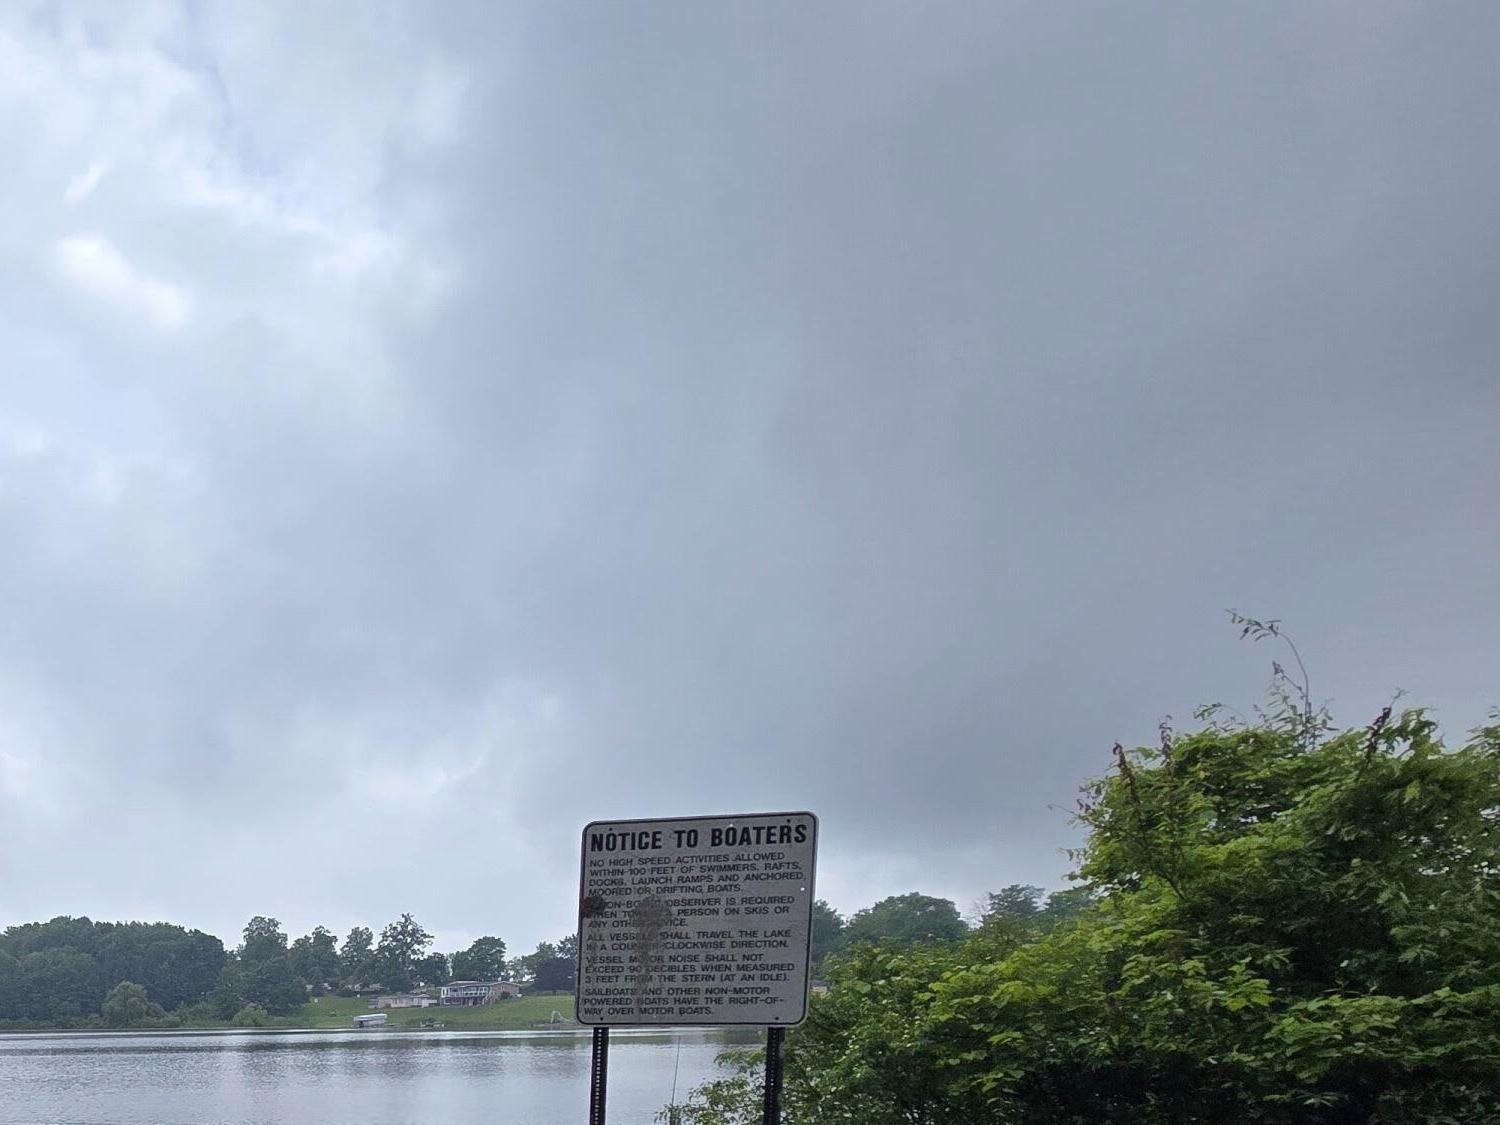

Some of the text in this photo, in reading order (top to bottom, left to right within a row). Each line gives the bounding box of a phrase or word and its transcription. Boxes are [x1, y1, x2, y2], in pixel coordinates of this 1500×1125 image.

[591, 824, 807, 852] NOTICE TO BOATERS
[609, 858, 633, 867] HIGH
[638, 857, 671, 865] SPEED
[676, 854, 729, 864] ACTIVITIES
[736, 852, 785, 861] ALLOWED
[651, 866, 676, 875] FEET
[680, 866, 696, 874] OF
[631, 877, 672, 885] LAUNCH
[677, 874, 713, 883] RAMPS
[717, 874, 740, 882] AND
[744, 872, 806, 881] ANCHORED,
[588, 884, 743, 896] MOORED OR DRIFTING BOATS.
[666, 898, 721, 907] OBSERVER
[726, 897, 736, 905] IS
[741, 895, 795, 905] REQUIRED
[677, 908, 719, 916] PERSON
[724, 907, 740, 915] ON
[744, 906, 769, 915] SKIS
[774, 906, 789, 914] OR
[660, 931, 691, 939] SHALL
[740, 930, 758, 938] THE
[764, 930, 791, 938] LAKE
[731, 940, 789, 948] DIRECTION.
[586, 956, 624, 964] VESSEL
[705, 954, 738, 962] SHALL
[629, 965, 642, 973] 90
[701, 964, 732, 972] WHEN
[737, 963, 795, 971] MEASURED
[596, 975, 620, 983] FEET
[657, 974, 677, 982] THE
[682, 974, 715, 982] STERN
[720, 974, 736, 982] (AT
[585, 988, 637, 996] SAILBOATS
[667, 987, 701, 995] OTHER
[705, 987, 770, 995] NON-MOTOR
[673, 997, 699, 1005] HAVE
[729, 997, 785, 1005] RIGHT-OF-
[584, 1006, 714, 1015] WAY OVER MOTOR BOATS.
